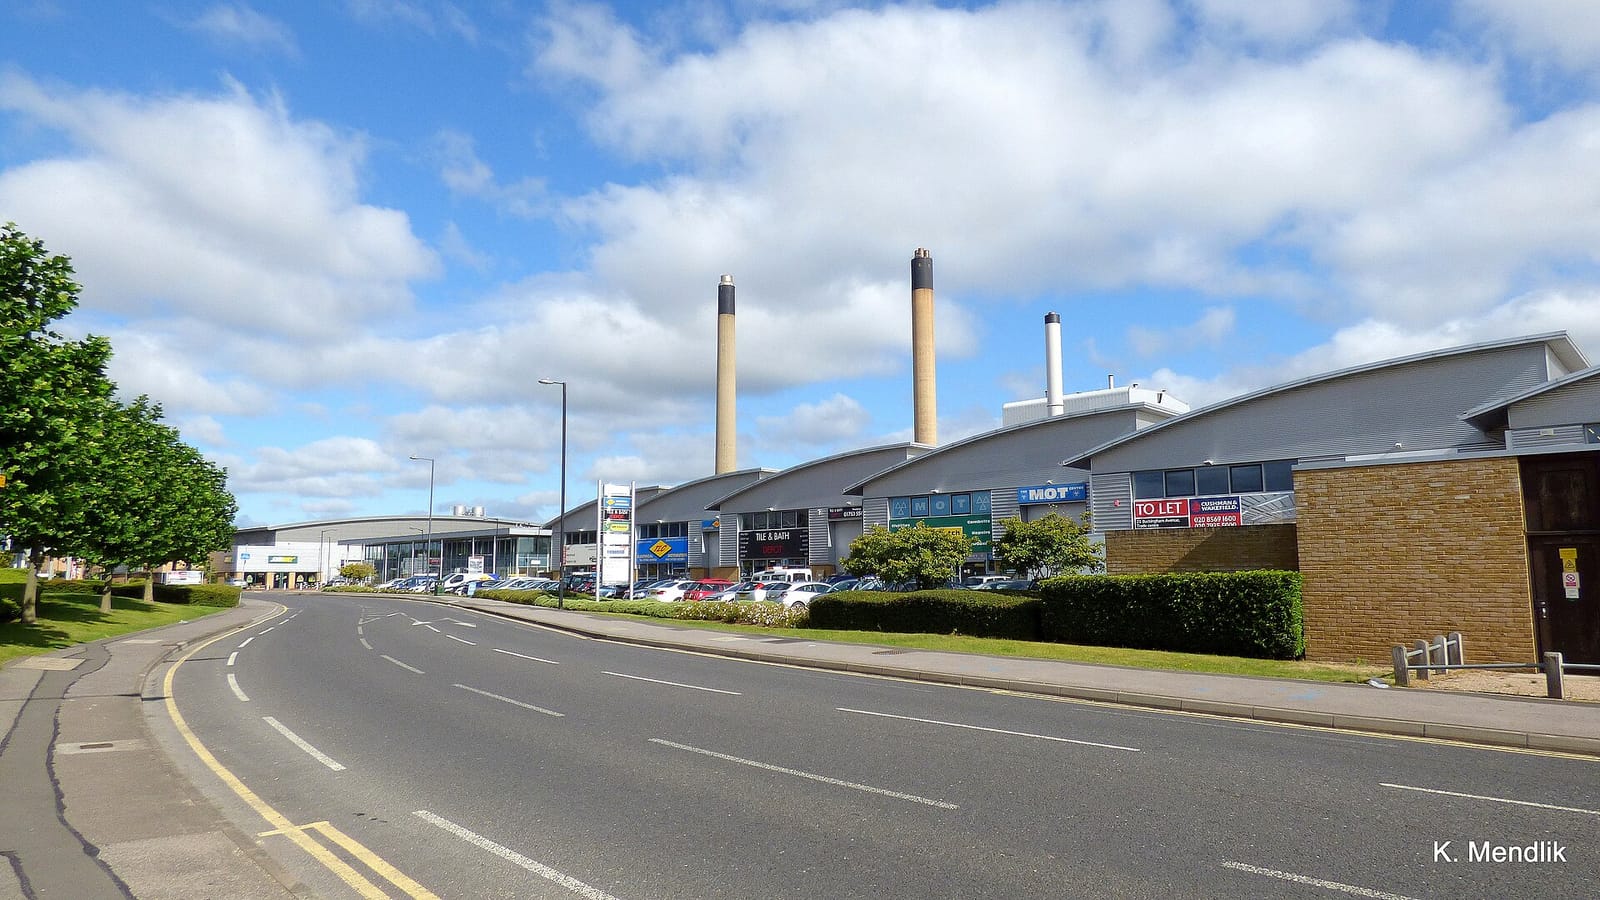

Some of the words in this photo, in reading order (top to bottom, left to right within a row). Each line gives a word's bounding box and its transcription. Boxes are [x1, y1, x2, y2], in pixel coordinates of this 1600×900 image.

[1136, 503, 1155, 516] TO
[1159, 502, 1182, 515] LET
[756, 533, 766, 541] TILE
[767, 532, 773, 541] &
[773, 532, 790, 541] BATH
